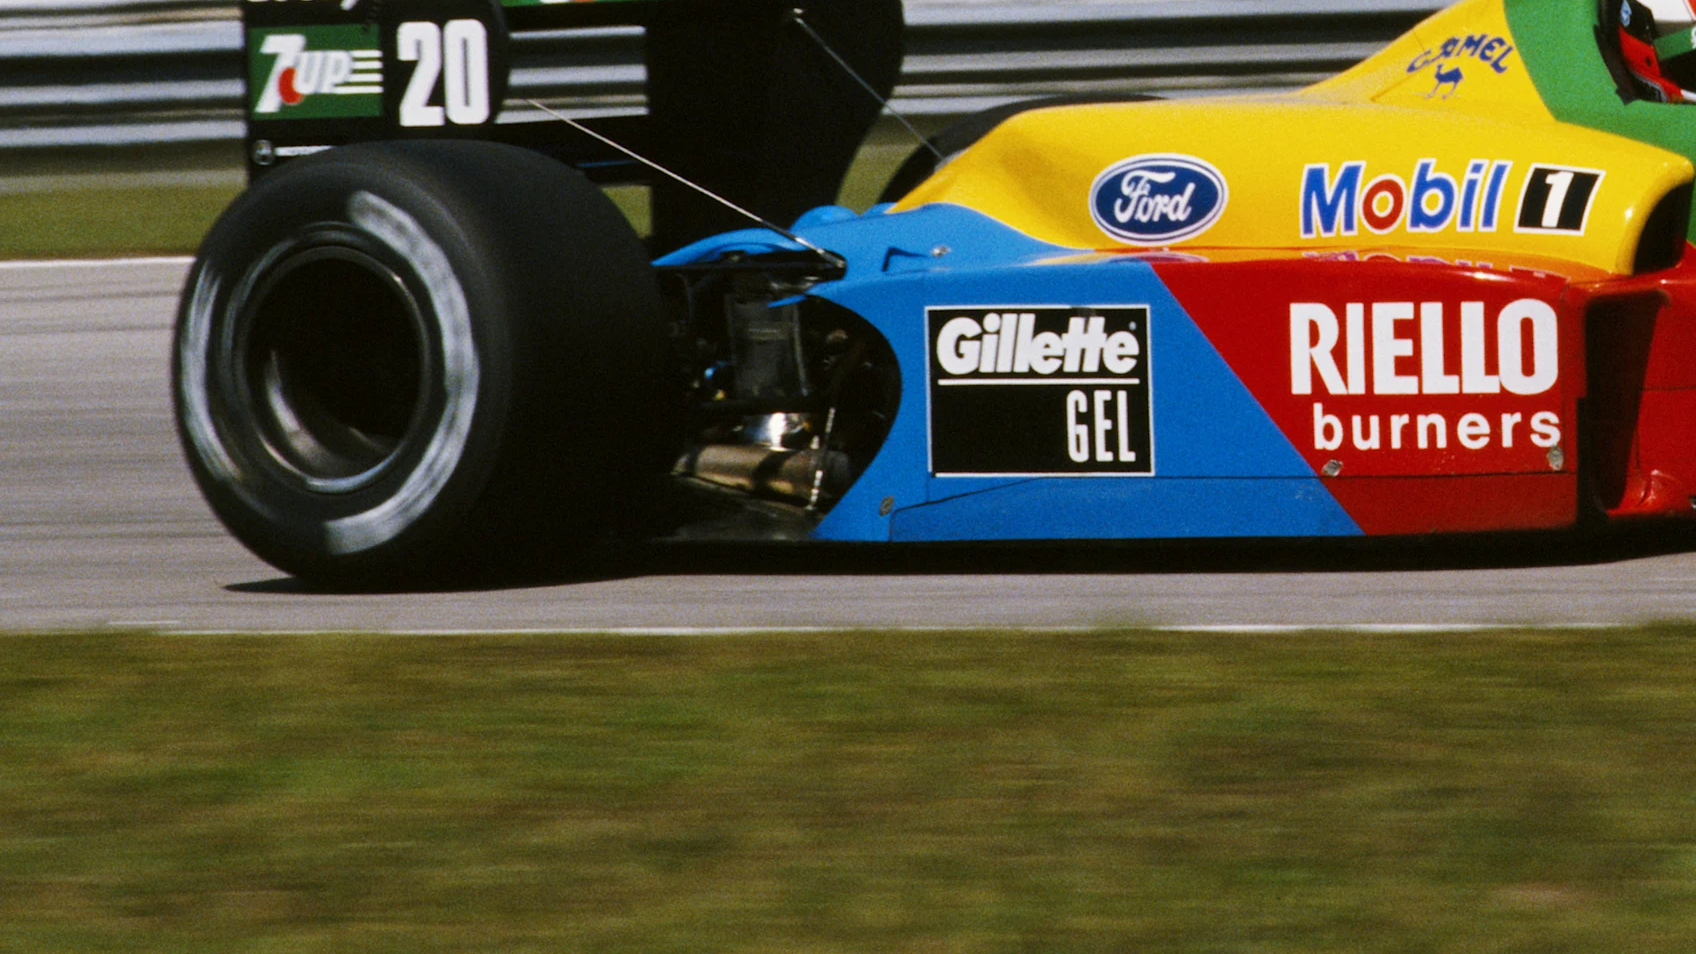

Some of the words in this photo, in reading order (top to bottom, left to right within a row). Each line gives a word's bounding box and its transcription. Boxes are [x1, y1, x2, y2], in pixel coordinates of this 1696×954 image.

[397, 18, 490, 127] 20
[1406, 33, 1513, 74] CAMEL
[1114, 169, 1196, 224] Ford
[1301, 158, 1513, 239] Mobil
[1545, 171, 1574, 228] 1
[936, 312, 1140, 375] Gillette
[1290, 298, 1559, 396] RIELLO
[1066, 389, 1136, 463] GEL
[1313, 402, 1562, 450] burners
